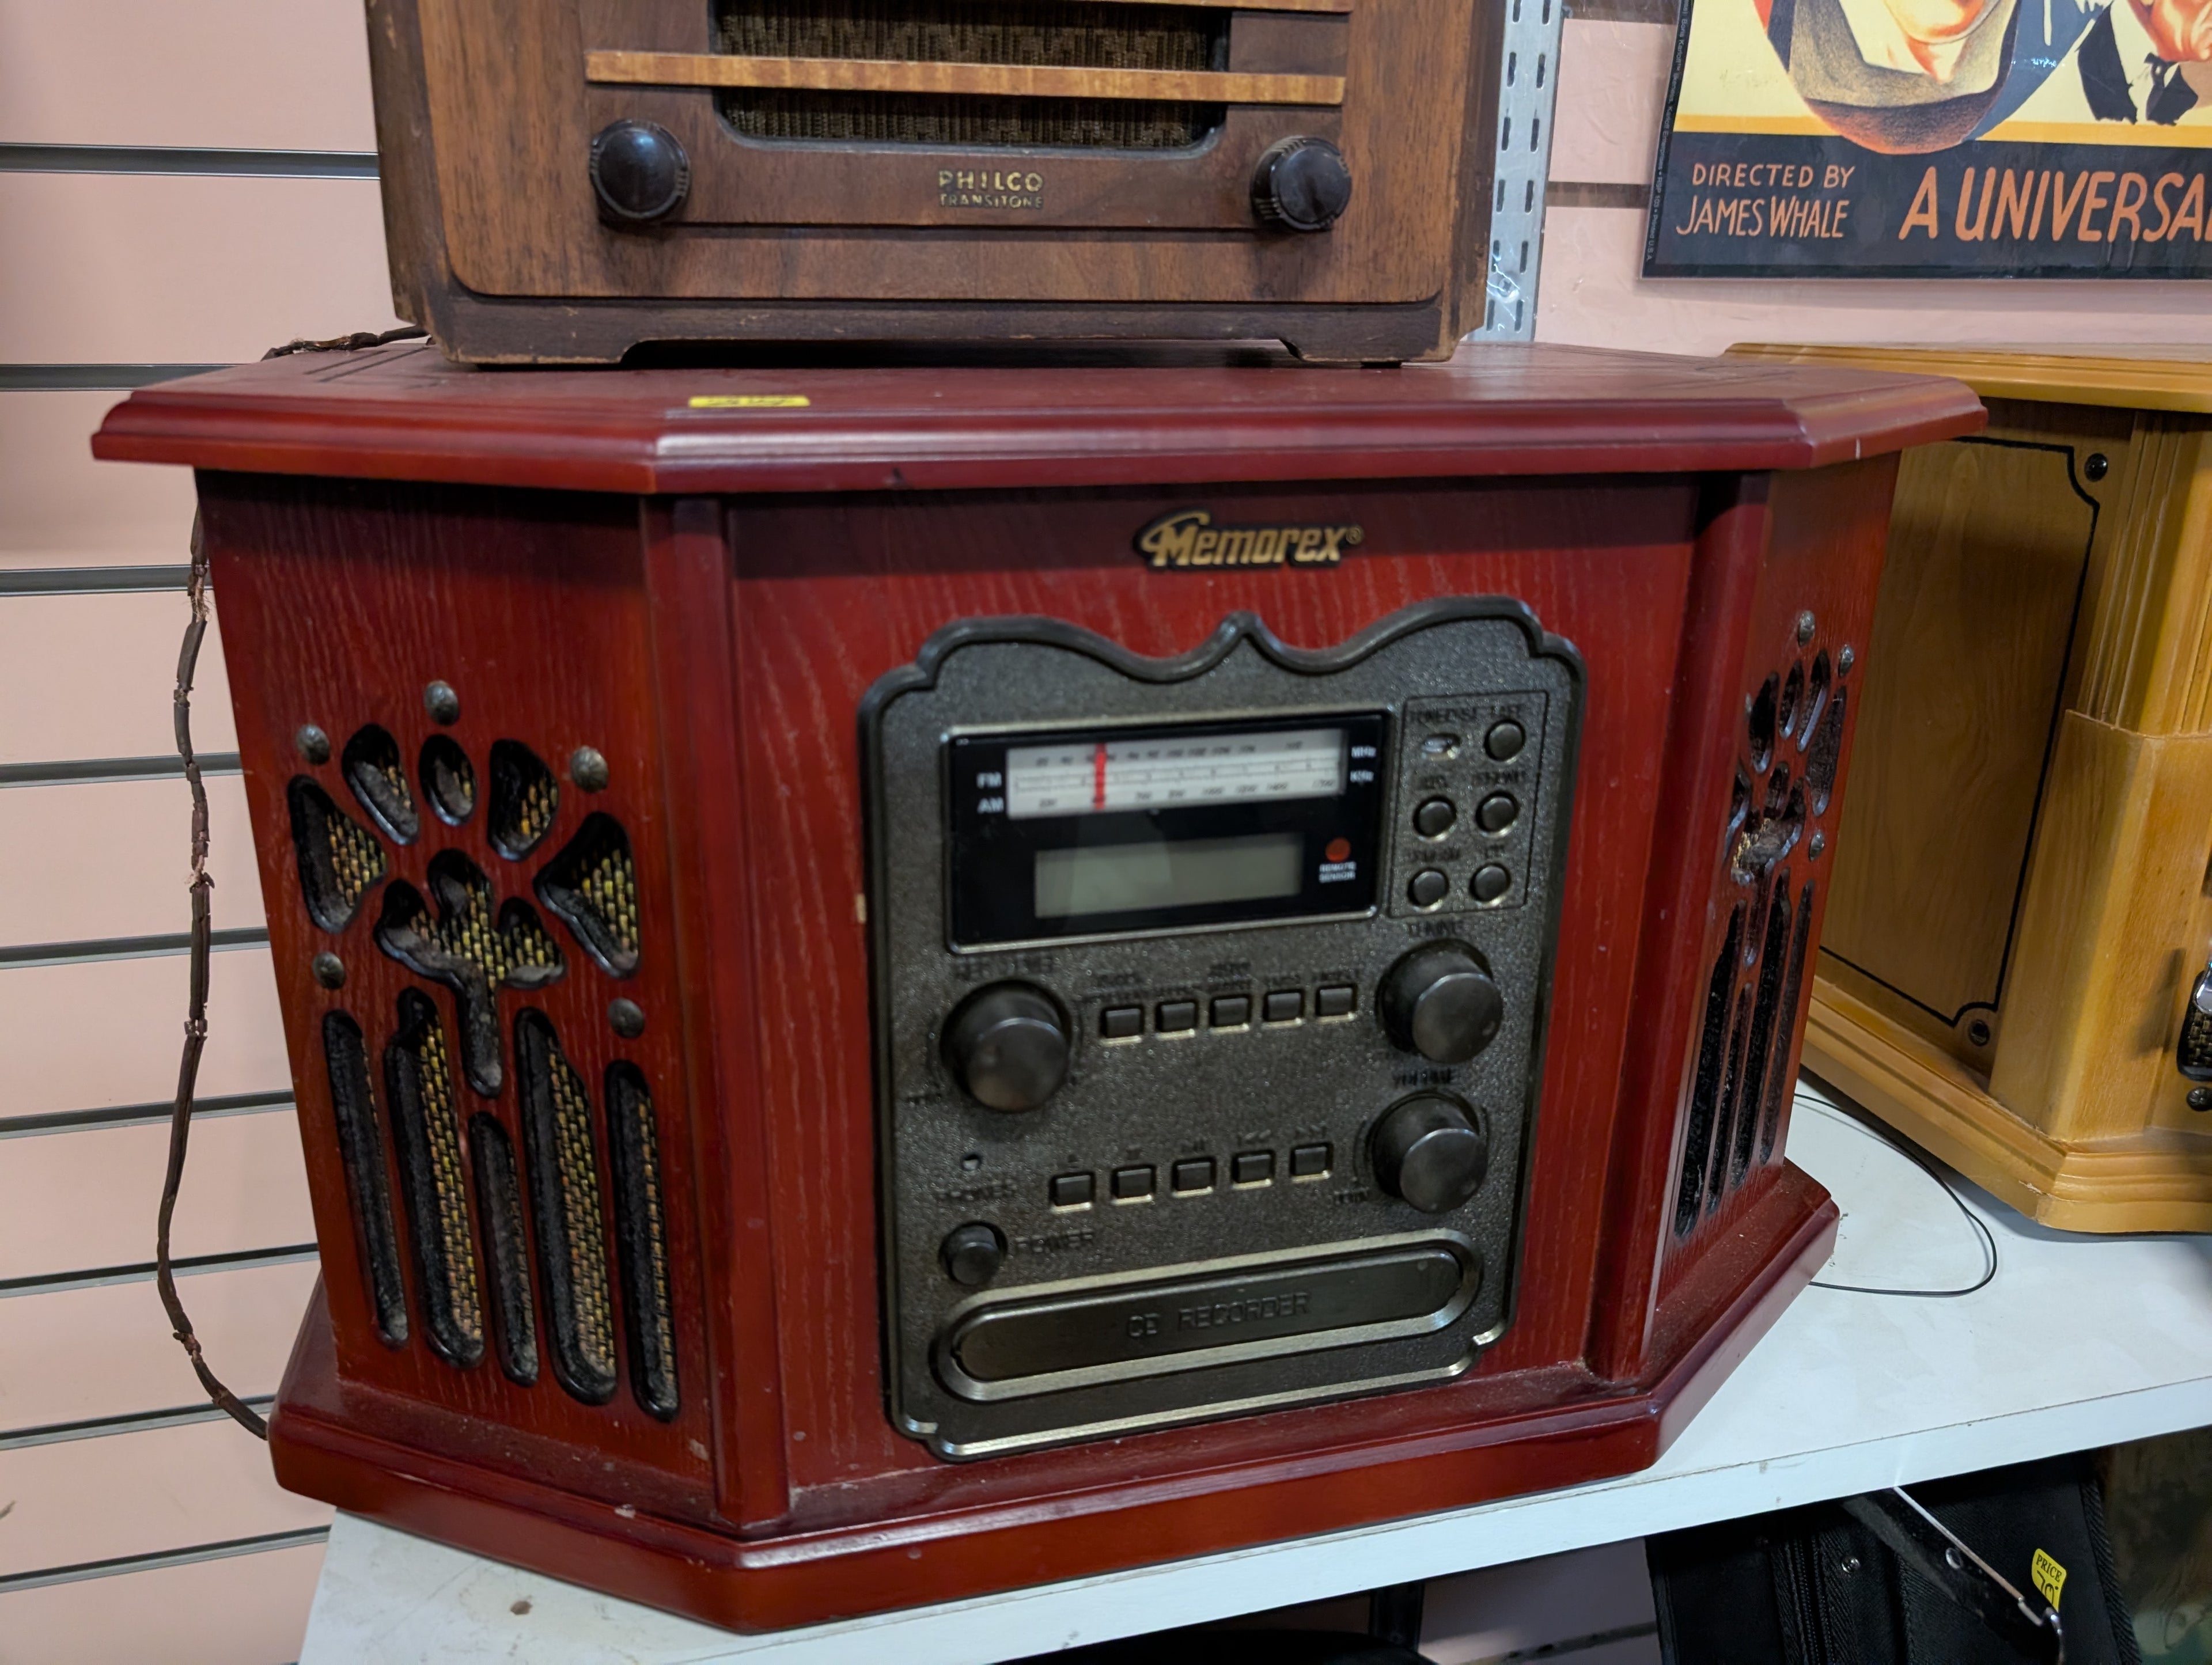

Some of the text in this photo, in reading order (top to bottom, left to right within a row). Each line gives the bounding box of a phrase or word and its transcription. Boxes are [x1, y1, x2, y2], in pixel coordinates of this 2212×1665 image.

[938, 170, 1043, 192] PHILCO
[1692, 163, 1855, 188] DIRECTED BY
[940, 194, 1043, 209] TRANSITONE
[1898, 165, 2212, 242] A UNIVERSA
[1675, 194, 1850, 238] JAMES WHALE
[976, 772, 1002, 789] FM
[977, 796, 1004, 813] AM
[1178, 1292, 1312, 1330] RECORDER
[2035, 1554, 2063, 1583] PRICE
